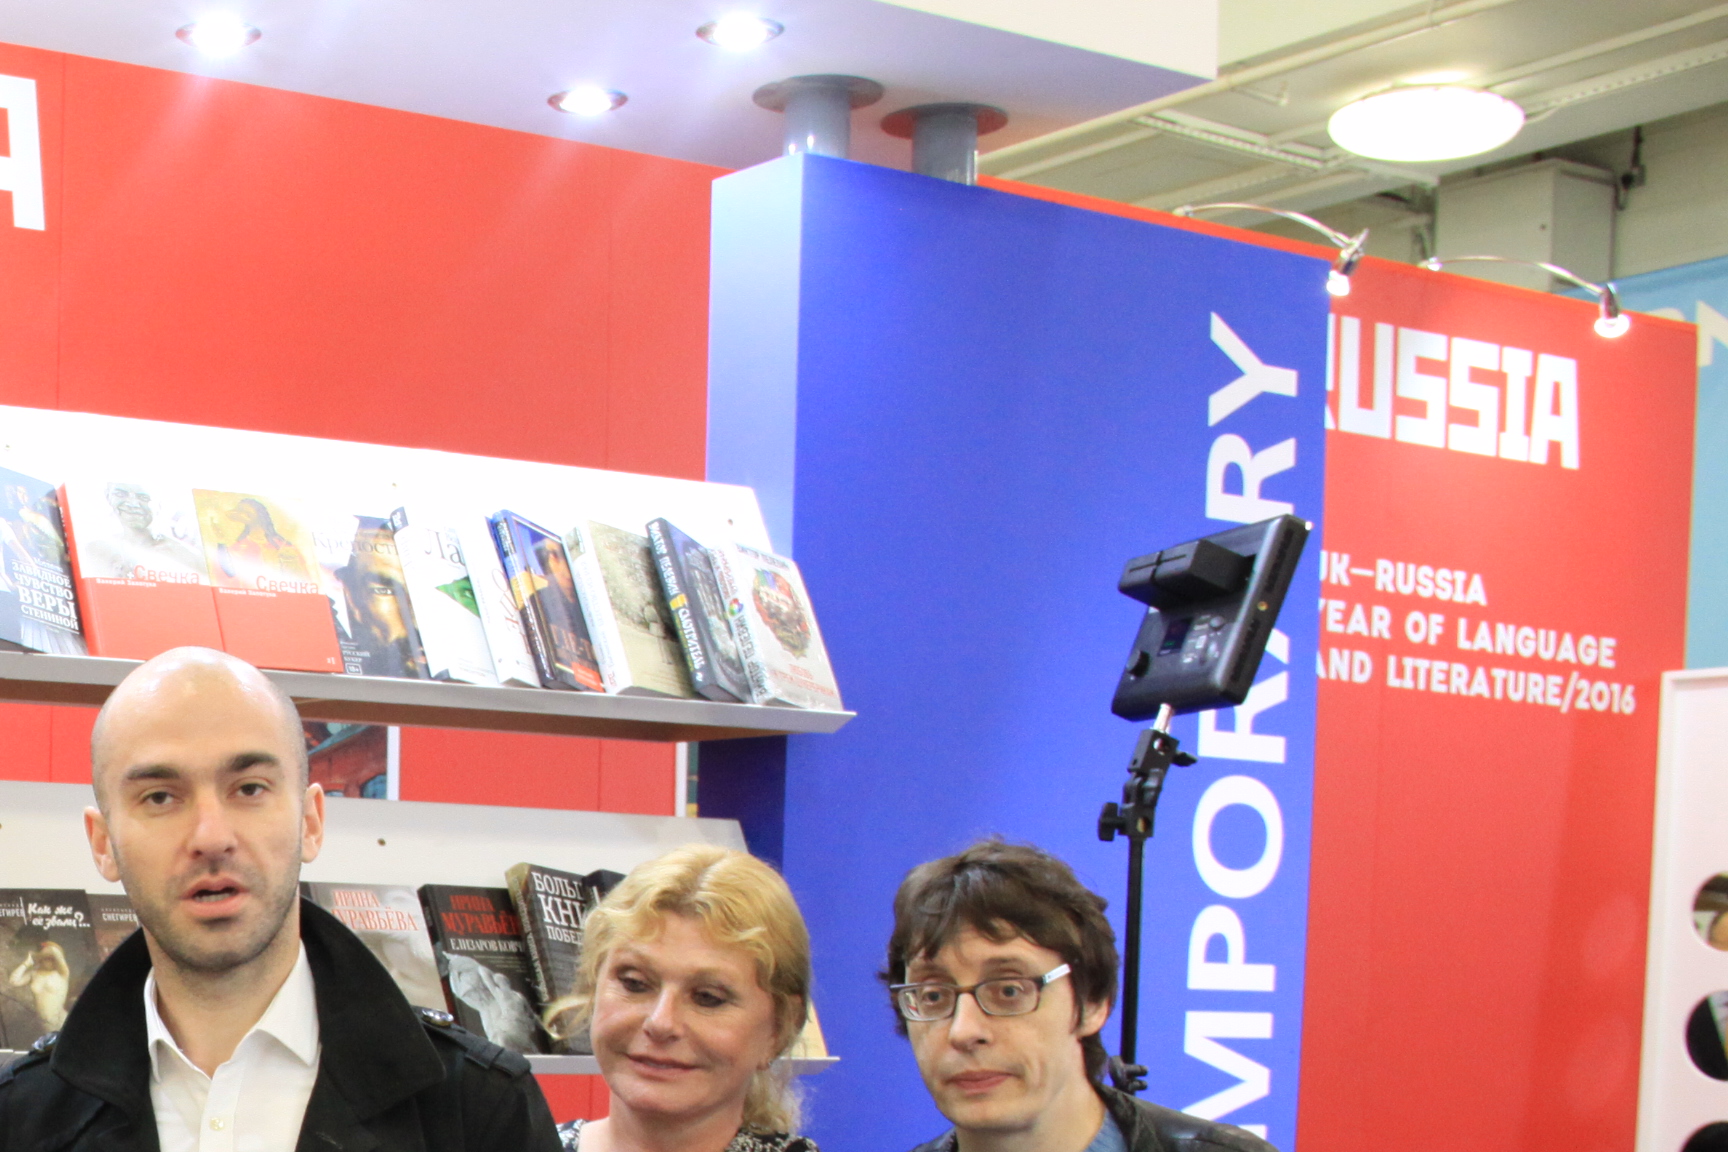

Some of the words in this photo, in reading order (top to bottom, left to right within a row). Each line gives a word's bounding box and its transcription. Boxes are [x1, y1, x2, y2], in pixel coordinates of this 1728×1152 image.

[312, 529, 398, 557] Крепост
[648, 520, 667, 555] ВИКТОР
[659, 556, 680, 595] ПЕЛЕВИН
[11, 561, 71, 588] ЗАВИДНОЕ
[14, 572, 74, 602] ЧУВСТВО
[133, 564, 200, 585] Свечка
[256, 574, 319, 595] Свечка
[17, 584, 77, 619] ВЕРЫ
[21, 604, 79, 631] СТЕНИНОЙ
[678, 607, 705, 670] СМОТРИТЕЛЬ
[1405, 611, 1445, 646] OF
[1457, 618, 1617, 669] LANGUAGE
[1387, 656, 1636, 714] LITERATURE/2016
[1180, 312, 1299, 1141] MPORRY
[28, 902, 50, 917] Как
[54, 905, 73, 915] же
[333, 890, 380, 908] ИРИНА
[449, 895, 495, 912] ИРИНА
